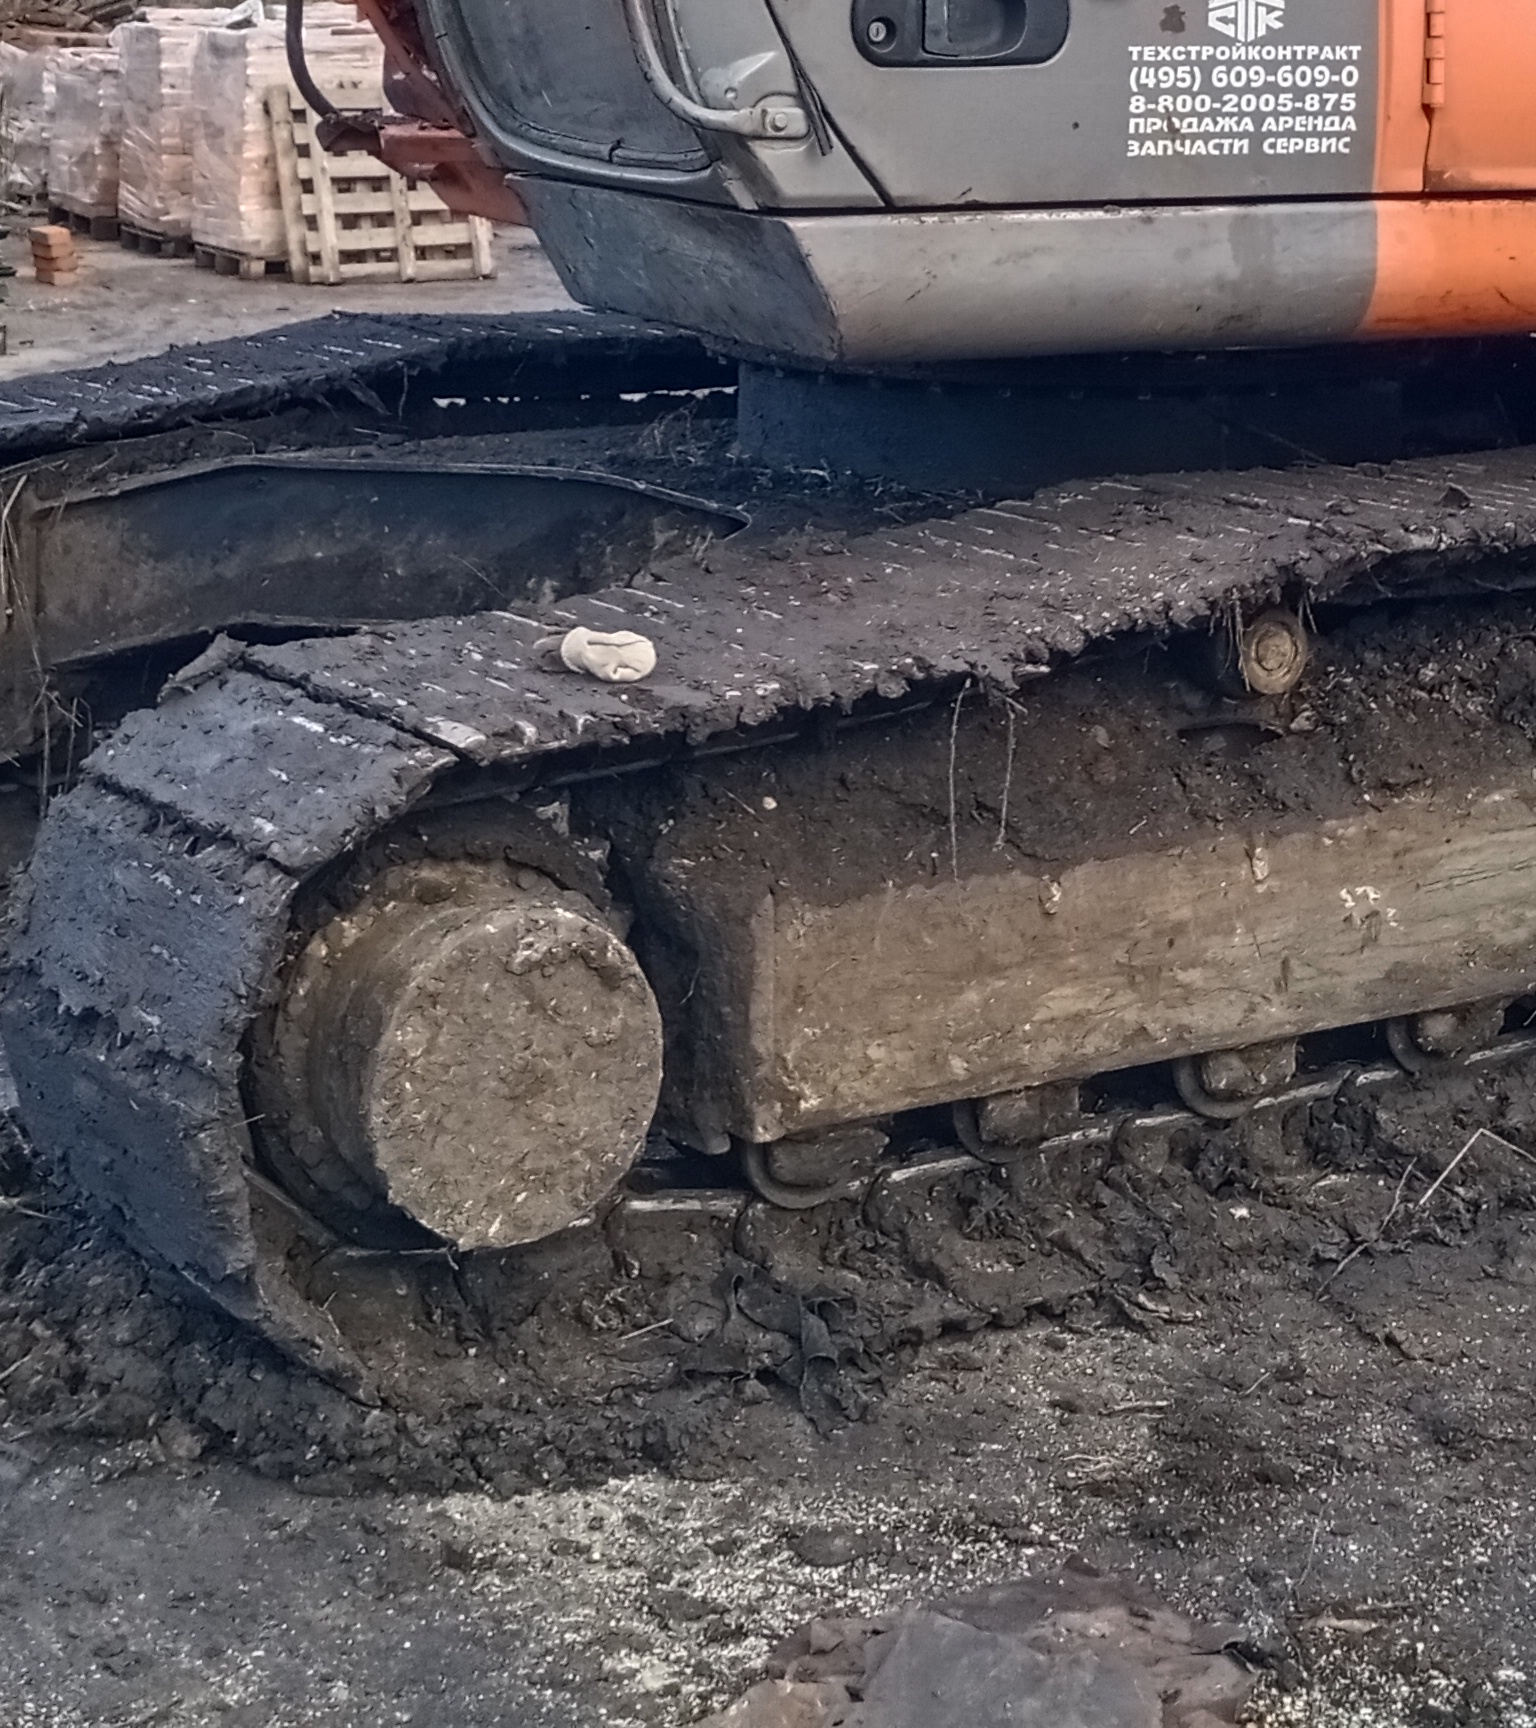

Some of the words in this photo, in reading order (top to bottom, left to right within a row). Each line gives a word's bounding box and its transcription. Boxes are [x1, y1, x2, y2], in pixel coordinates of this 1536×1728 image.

[1128, 42, 1361, 61] ТЕХСТРОЙКОНТРАКТ
[1129, 65, 1201, 91] (495)
[1211, 66, 1359, 88] 609-609-0
[1129, 93, 1357, 113] 8-800-2005-875
[1128, 116, 1254, 134] ПРОДАЖА
[1261, 115, 1357, 132] АРЕНДА
[1127, 138, 1249, 157] ЗАПЧАСТИ
[1262, 137, 1351, 155] СЕРВИС
